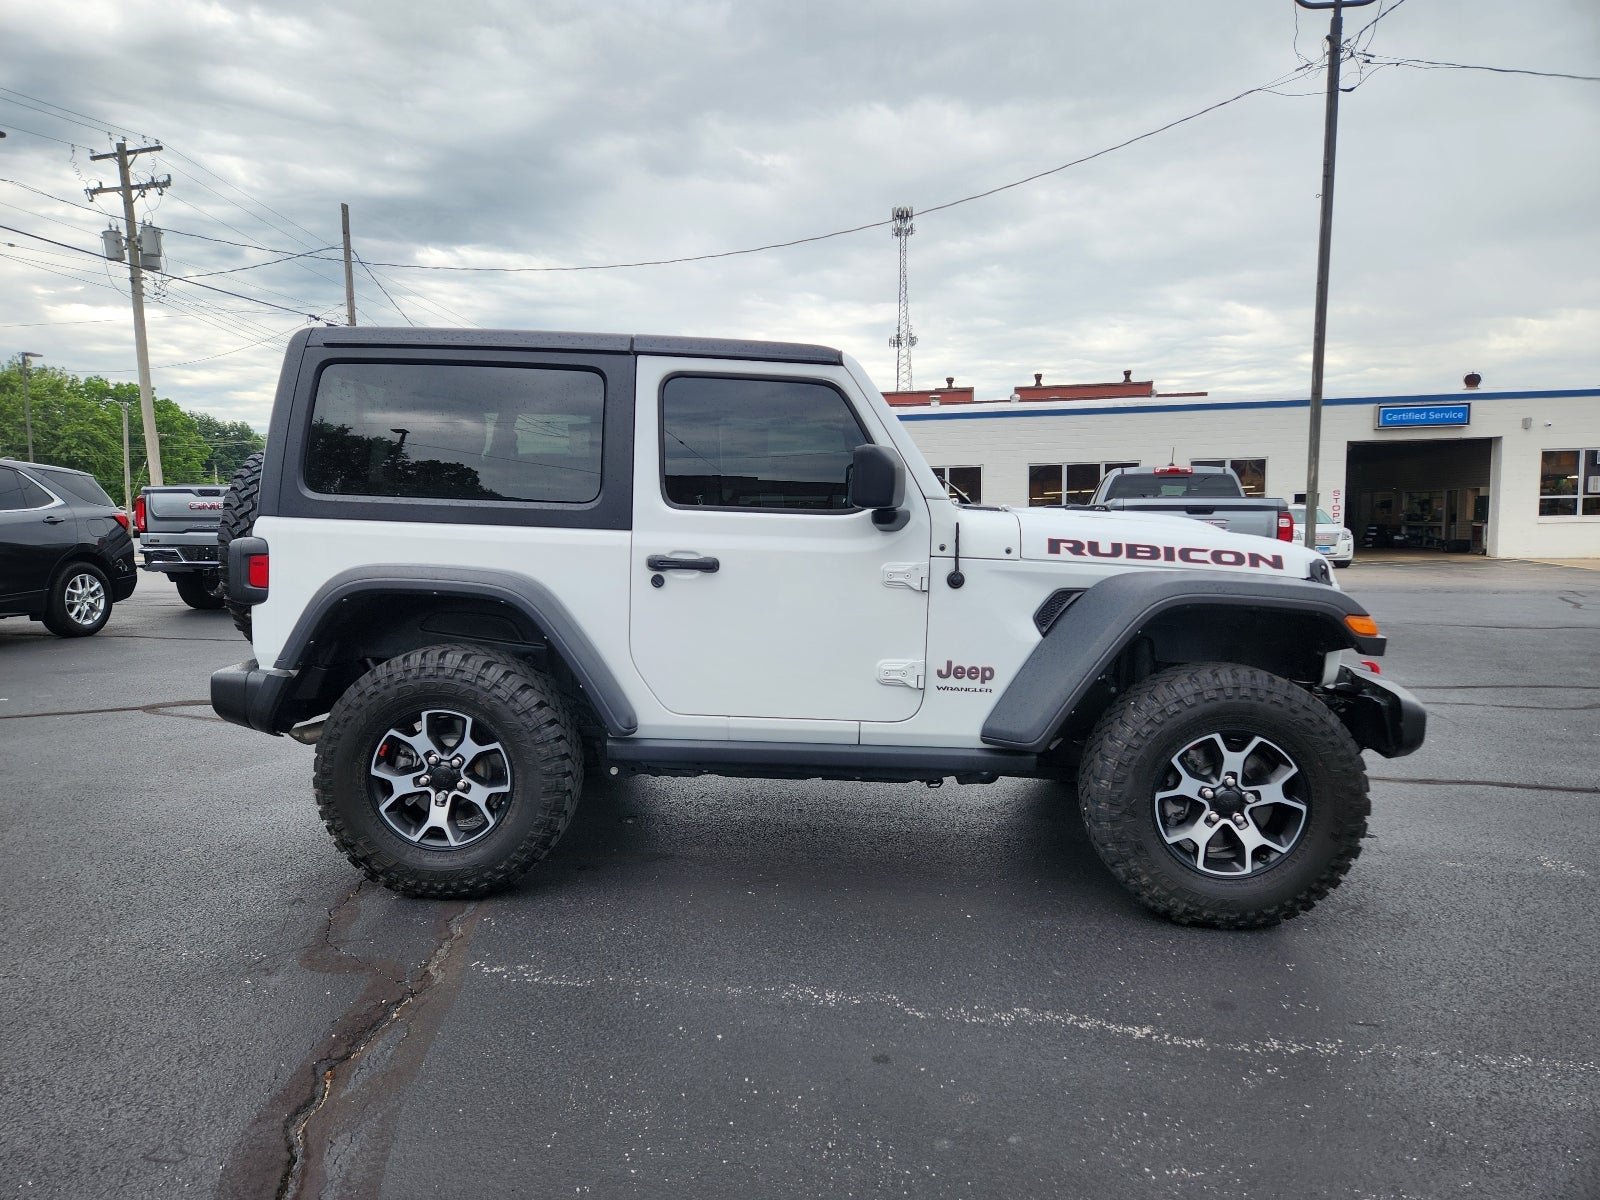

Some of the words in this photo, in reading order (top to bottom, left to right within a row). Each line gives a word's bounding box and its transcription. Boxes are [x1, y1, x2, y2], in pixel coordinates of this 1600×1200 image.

[1385, 412, 1427, 421] Certified
[1428, 411, 1464, 420] Service
[1332, 489, 1341, 521] STOP
[1047, 537, 1284, 570] RUBICON
[936, 659, 995, 685] Jeep
[935, 685, 993, 694] WRANGLER
